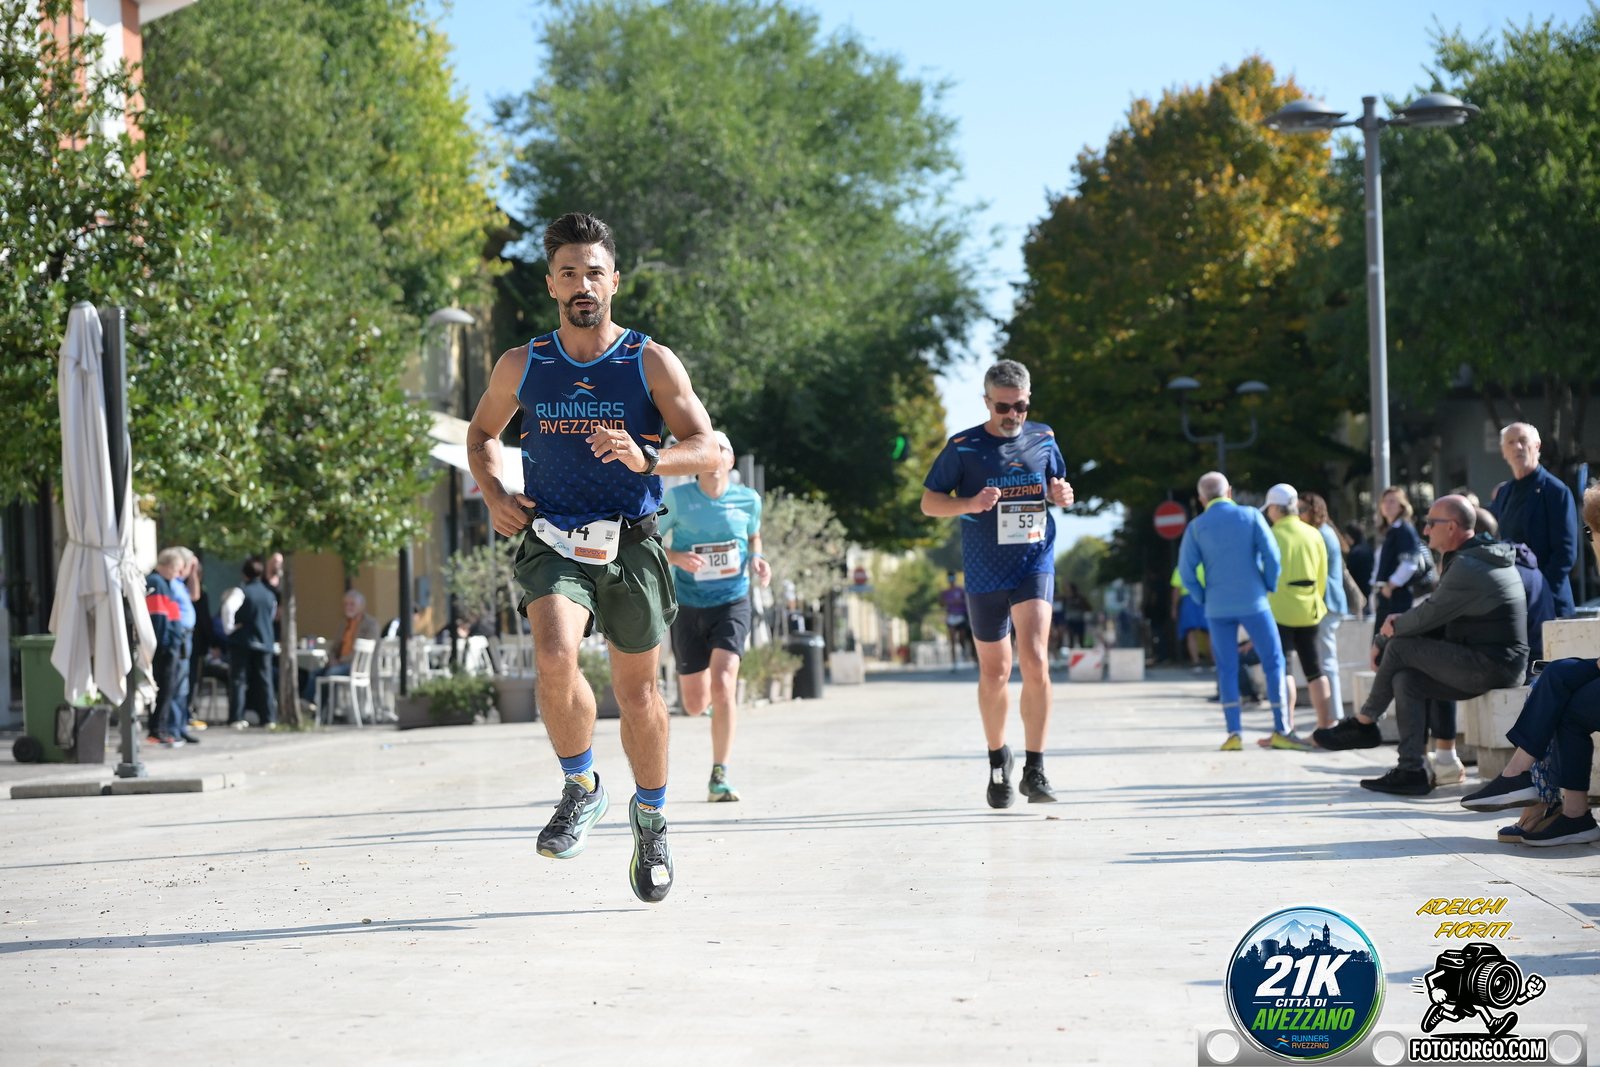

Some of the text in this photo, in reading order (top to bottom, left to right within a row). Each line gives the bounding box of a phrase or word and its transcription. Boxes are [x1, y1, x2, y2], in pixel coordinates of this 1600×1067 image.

[535, 401, 625, 418] RUNNERS
[987, 473, 1042, 487] RUNNERS
[1019, 514, 1034, 528] 53
[708, 553, 728, 567] 120
